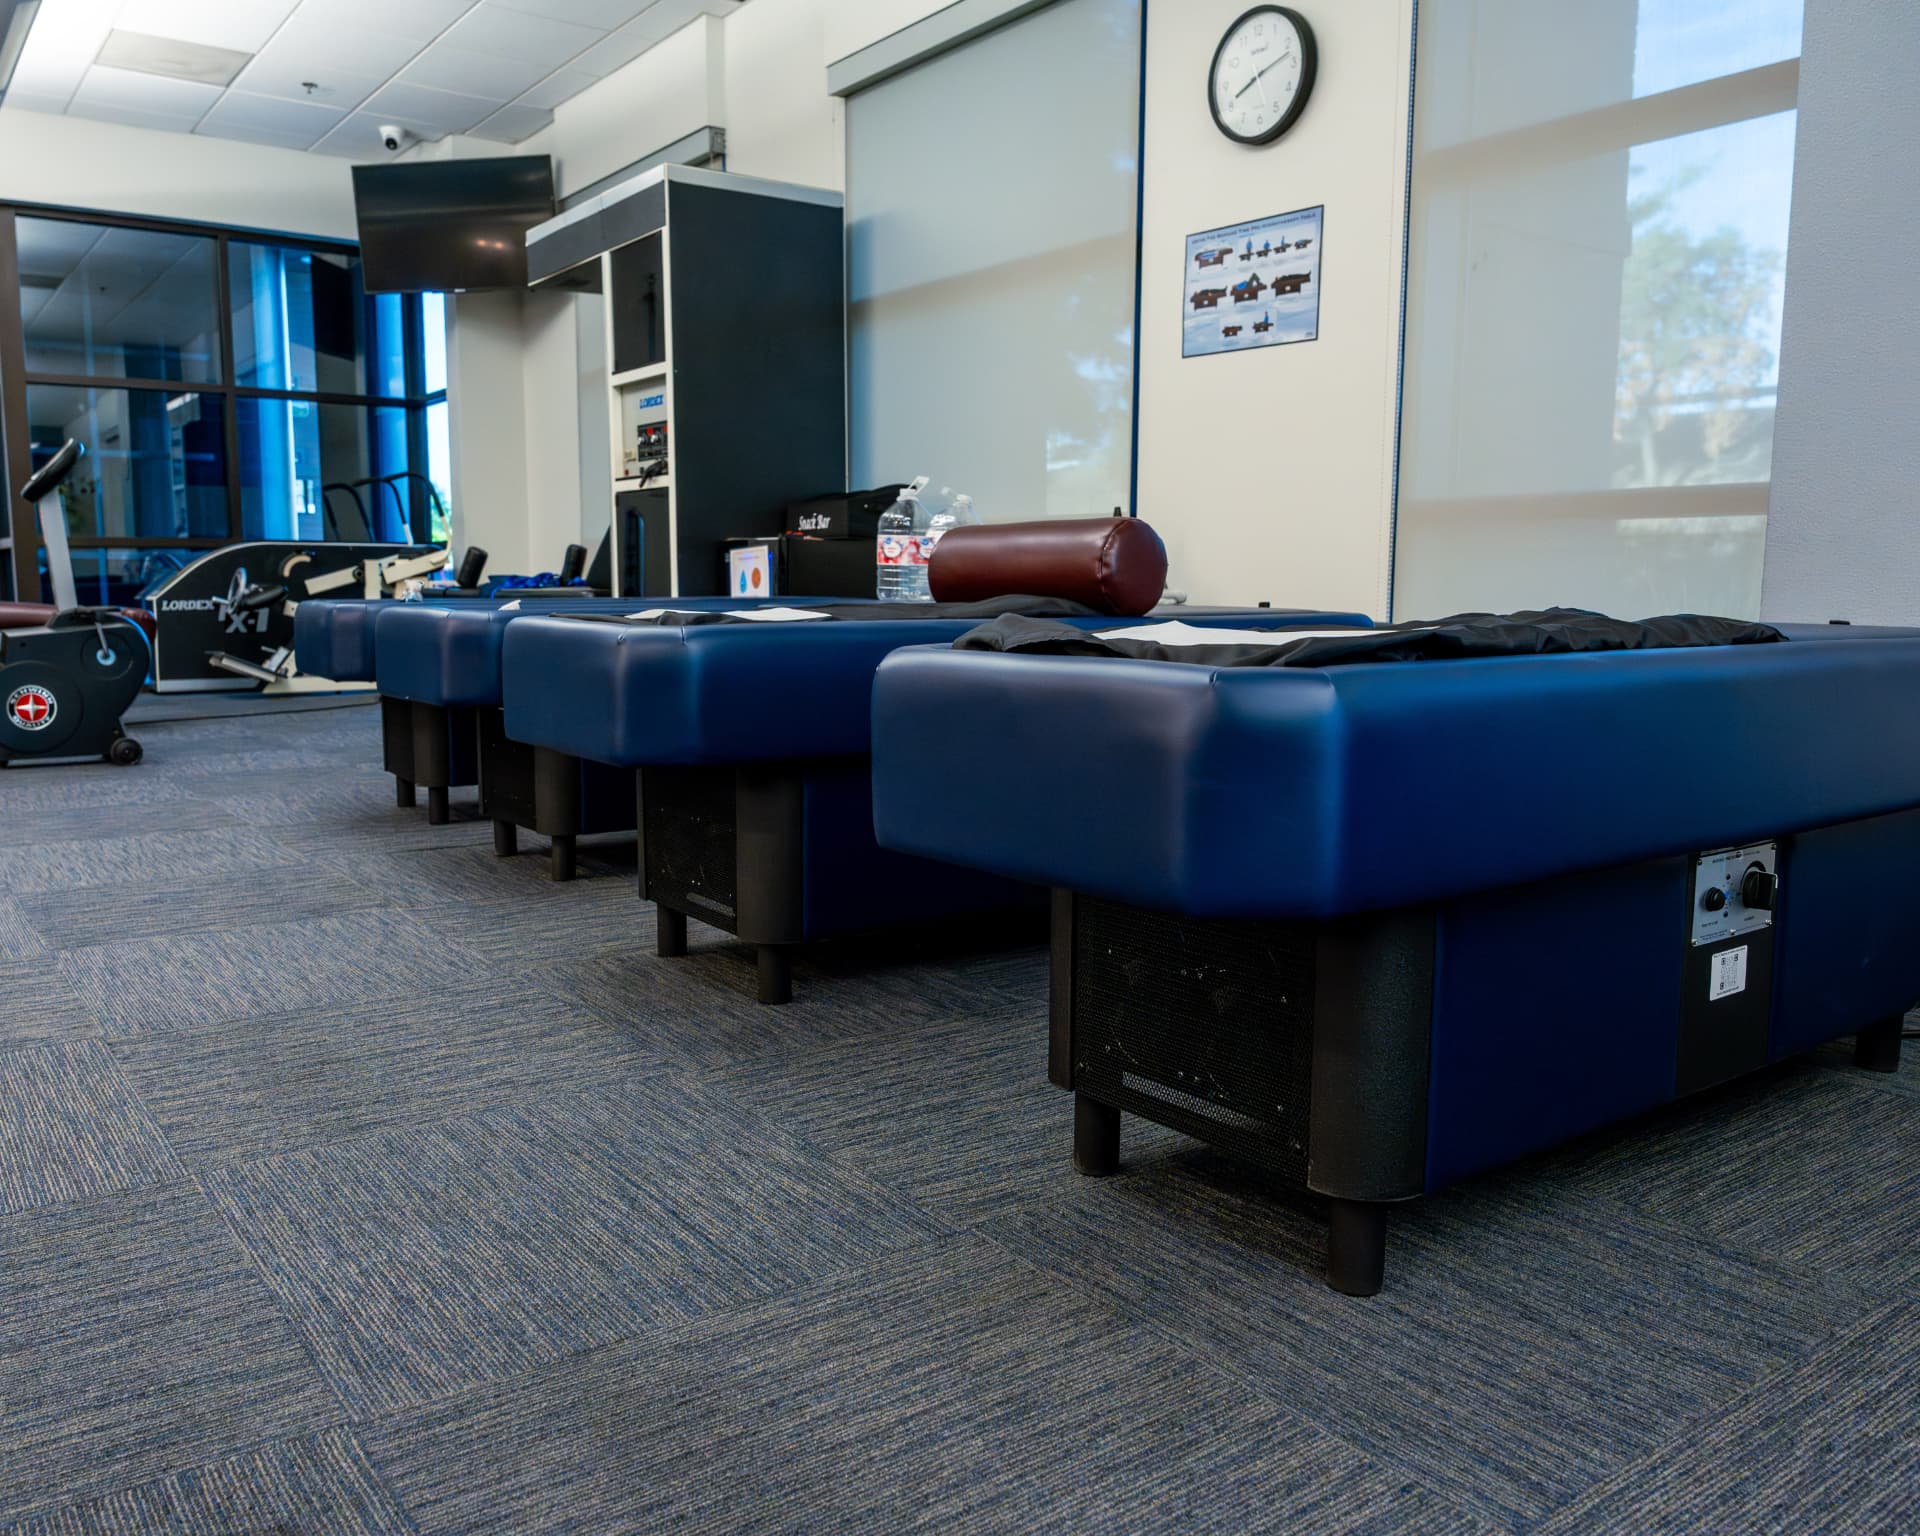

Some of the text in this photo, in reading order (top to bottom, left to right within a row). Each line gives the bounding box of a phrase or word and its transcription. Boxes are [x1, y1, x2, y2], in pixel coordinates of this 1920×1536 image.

[798, 512, 831, 531] Snack Bar
[161, 599, 215, 611] LORDEX
[10, 687, 54, 705] SCHWINN
